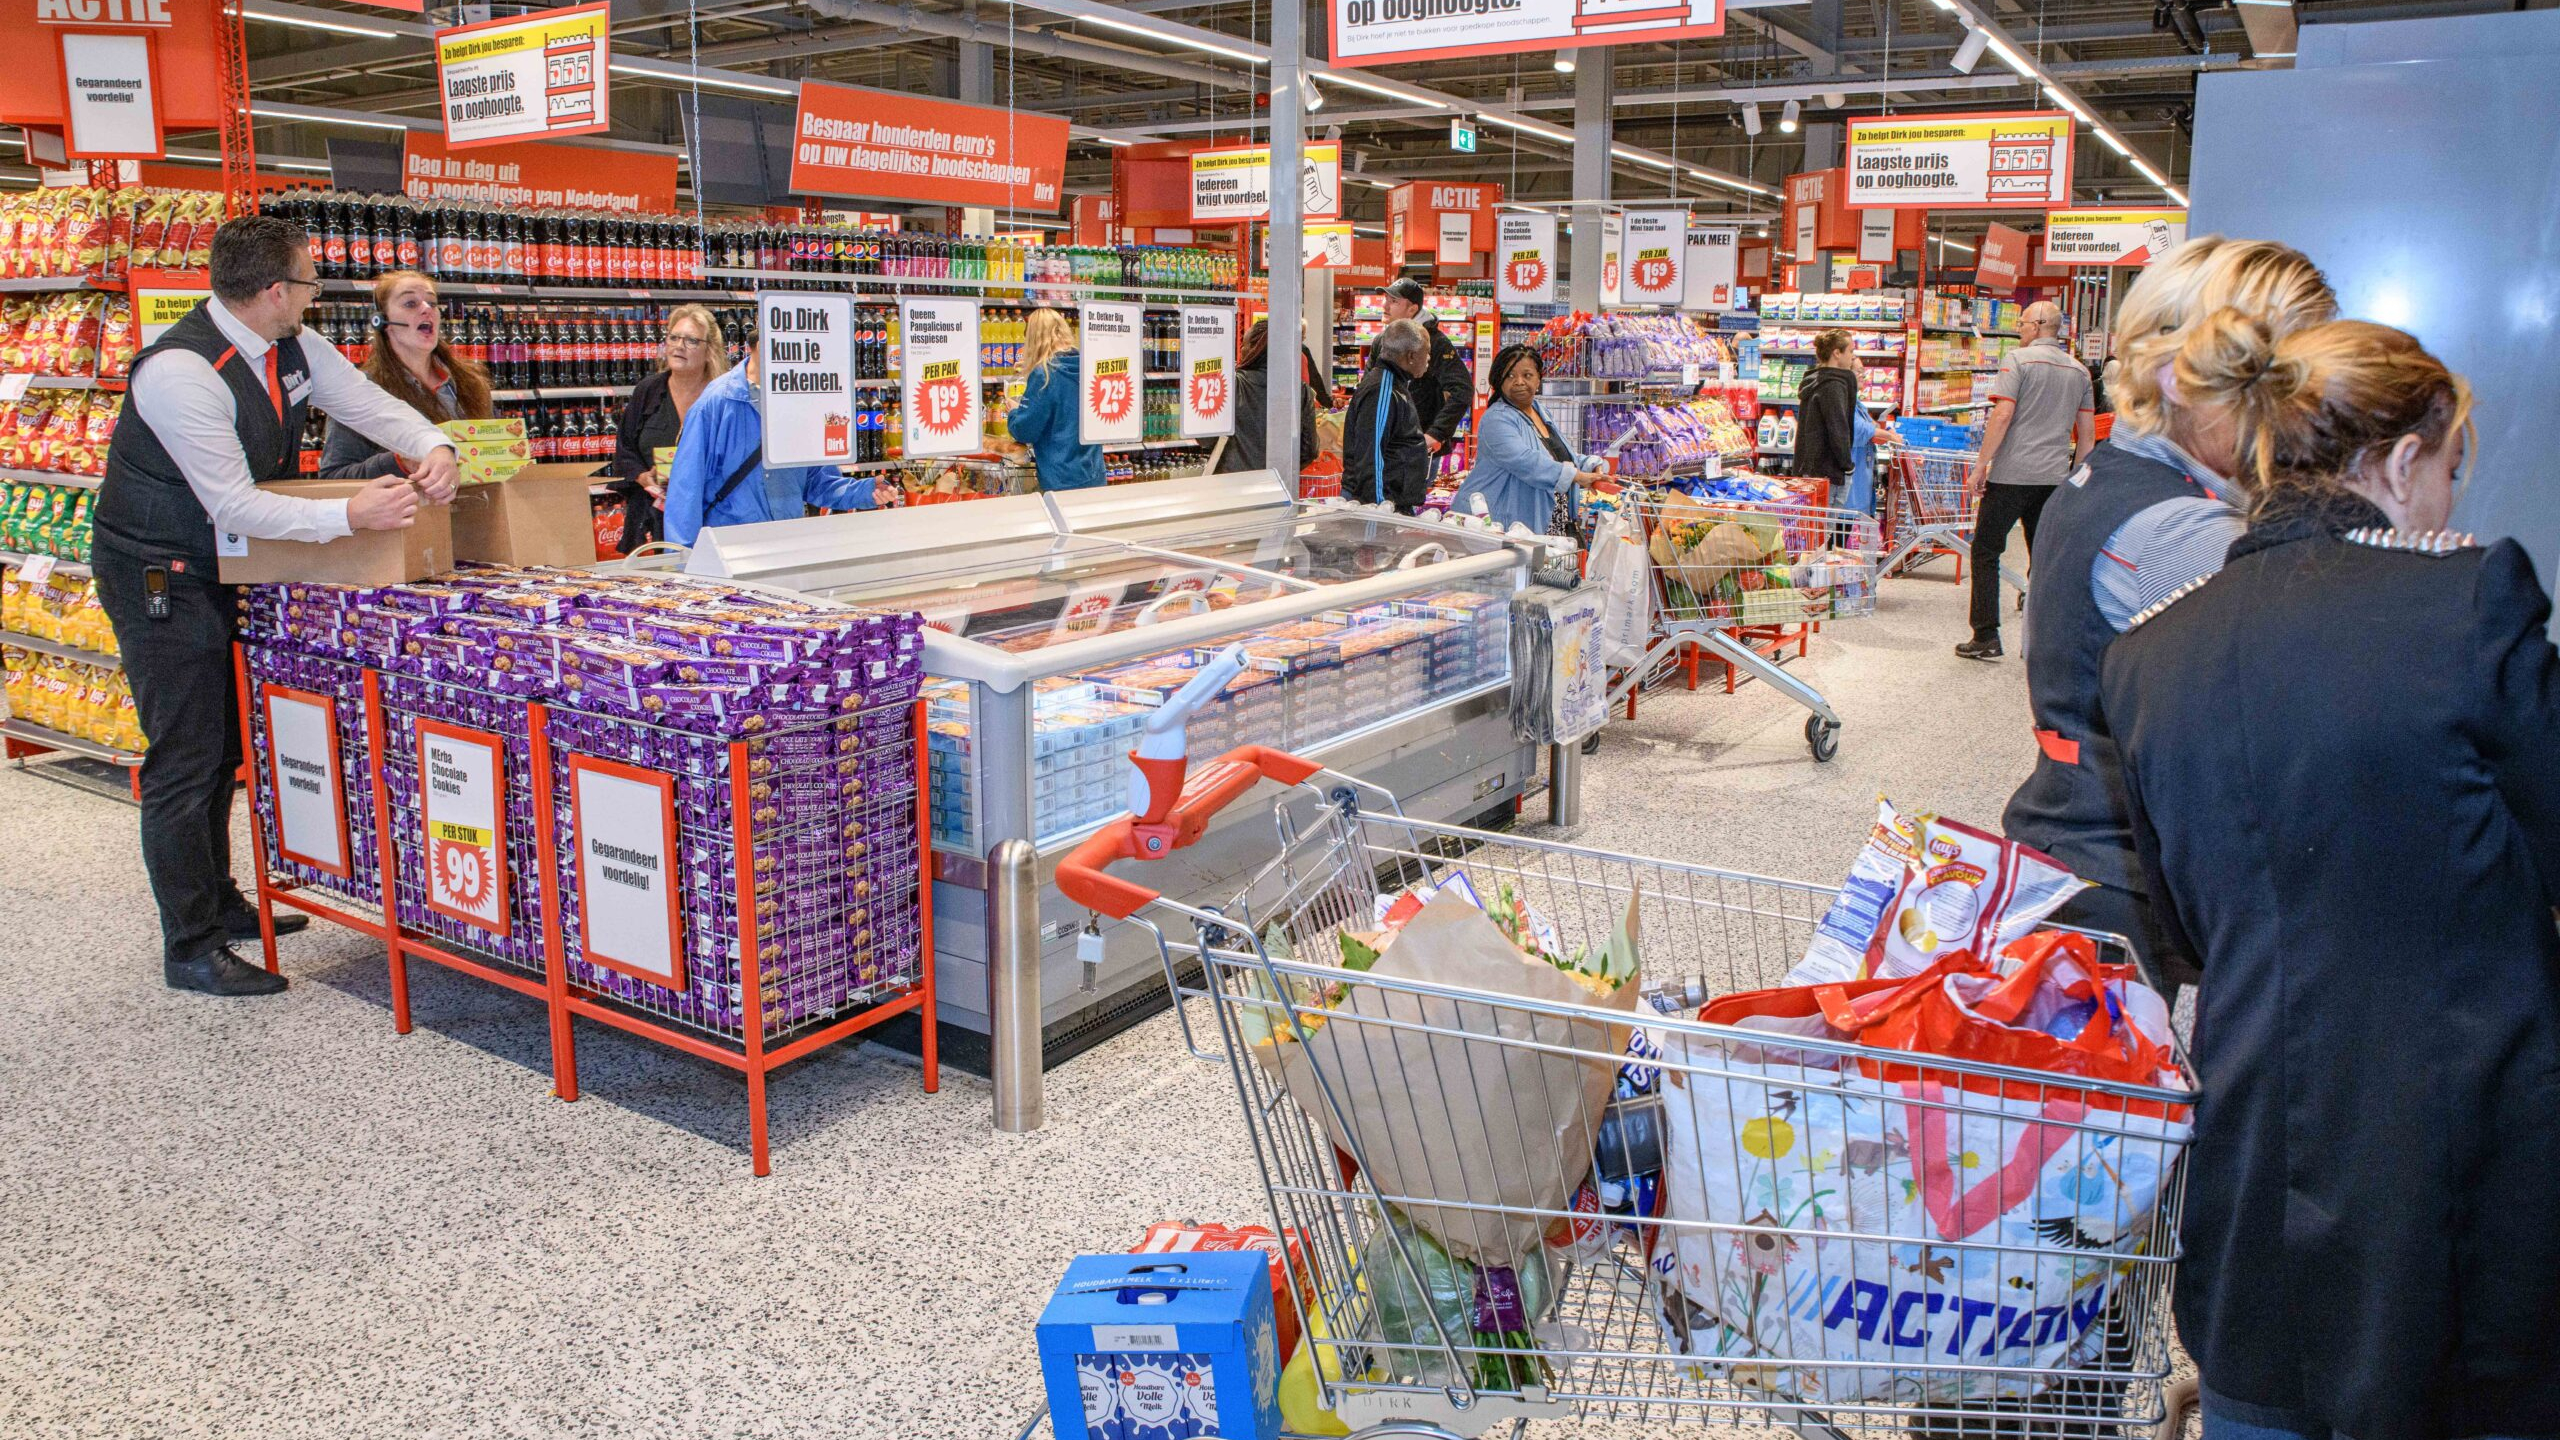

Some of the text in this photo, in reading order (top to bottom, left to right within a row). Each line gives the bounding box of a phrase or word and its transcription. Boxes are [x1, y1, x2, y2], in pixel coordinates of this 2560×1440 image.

[1347, 0, 1375, 26] op
[1417, 26, 1441, 34] bukken
[1460, 21, 1495, 32] goedkope
[445, 36, 525, 59] Zo helpt Dirk jou besparen:
[77, 77, 142, 90] Gegarandeerd
[448, 69, 516, 99] Laagste prijs
[88, 92, 134, 103] voordelig!
[450, 95, 525, 122] op ooghoogte.
[802, 112, 996, 160] Bespaar honderden euro's
[1858, 128, 1966, 142] Zo helpt Dirk jou besparen:
[408, 153, 520, 182] Dag in dag uit
[799, 143, 1031, 186] op uw dagelijkse boodschappen
[1201, 159, 1217, 168] helpt
[1217, 158, 1228, 166] Dirk
[1228, 158, 1238, 166] jou
[1856, 153, 1949, 171] Laagste prijs
[1303, 165, 1316, 175] irk
[1196, 179, 1238, 192] Iedereen
[1855, 172, 1959, 188] op ooghoogte.
[407, 177, 429, 199] de
[535, 189, 563, 206] van
[565, 189, 639, 211] Nederland
[1034, 183, 1055, 201] Dirk
[1431, 186, 1481, 208] ACTIE
[1795, 177, 1824, 203] ACTIE
[1196, 190, 1269, 208] krijgt voordeel.
[2059, 216, 2074, 224] helpt
[2051, 231, 2094, 241] Iedereen
[2153, 225, 2168, 234] Dirk
[1687, 234, 1731, 246] PAK MEE!
[2051, 241, 2122, 253] krijgt voordeel.
[443, 248, 462, 261] Cola
[484, 251, 502, 263] Cola
[1512, 249, 1539, 261] PER ZAK
[1640, 248, 1668, 259] PER ZAK
[155, 298, 191, 310] Zo helpt
[153, 310, 168, 321] jou
[770, 306, 830, 332] Op Dirk
[910, 308, 936, 320] Queens
[1088, 310, 1124, 324] Dr. Oetker Big
[910, 321, 963, 332] Pangalicious of
[1088, 321, 1131, 334] Americans pizza
[1194, 316, 1210, 326] Oetker
[1210, 317, 1219, 327] Big
[1187, 325, 1224, 336] Americans pizza
[910, 333, 947, 345] visspiesen
[771, 338, 821, 363] kun je
[924, 361, 958, 380] PER PAK
[1096, 358, 1128, 374] PER STUK
[1194, 358, 1222, 374] PER STUK
[282, 370, 305, 391] Dirk
[771, 369, 843, 392] rekenen.
[827, 438, 845, 451] Dirk
[1621, 570, 1640, 646] primarkcom
[738, 640, 771, 650] CHOCOLATE
[760, 649, 783, 657] COOKIES
[704, 666, 736, 675] CHOCOLATE
[669, 695, 700, 704] CHOCOLATE
[431, 747, 453, 764] MErba
[280, 753, 325, 777] Gegarandeerd
[431, 762, 468, 783] Chocolate
[288, 776, 321, 795] voordelig!
[432, 776, 461, 795] Cookies
[442, 823, 479, 844] PER STUK
[591, 837, 658, 870] Gegarandeerd
[446, 846, 481, 898] 99
[602, 865, 650, 891] voordelig!
[1073, 1277, 1124, 1288] HOUDBARE
[1823, 1278, 2107, 1357] ACTION
[1137, 1392, 1164, 1401] Volle
[1140, 1403, 1163, 1411] Melk
